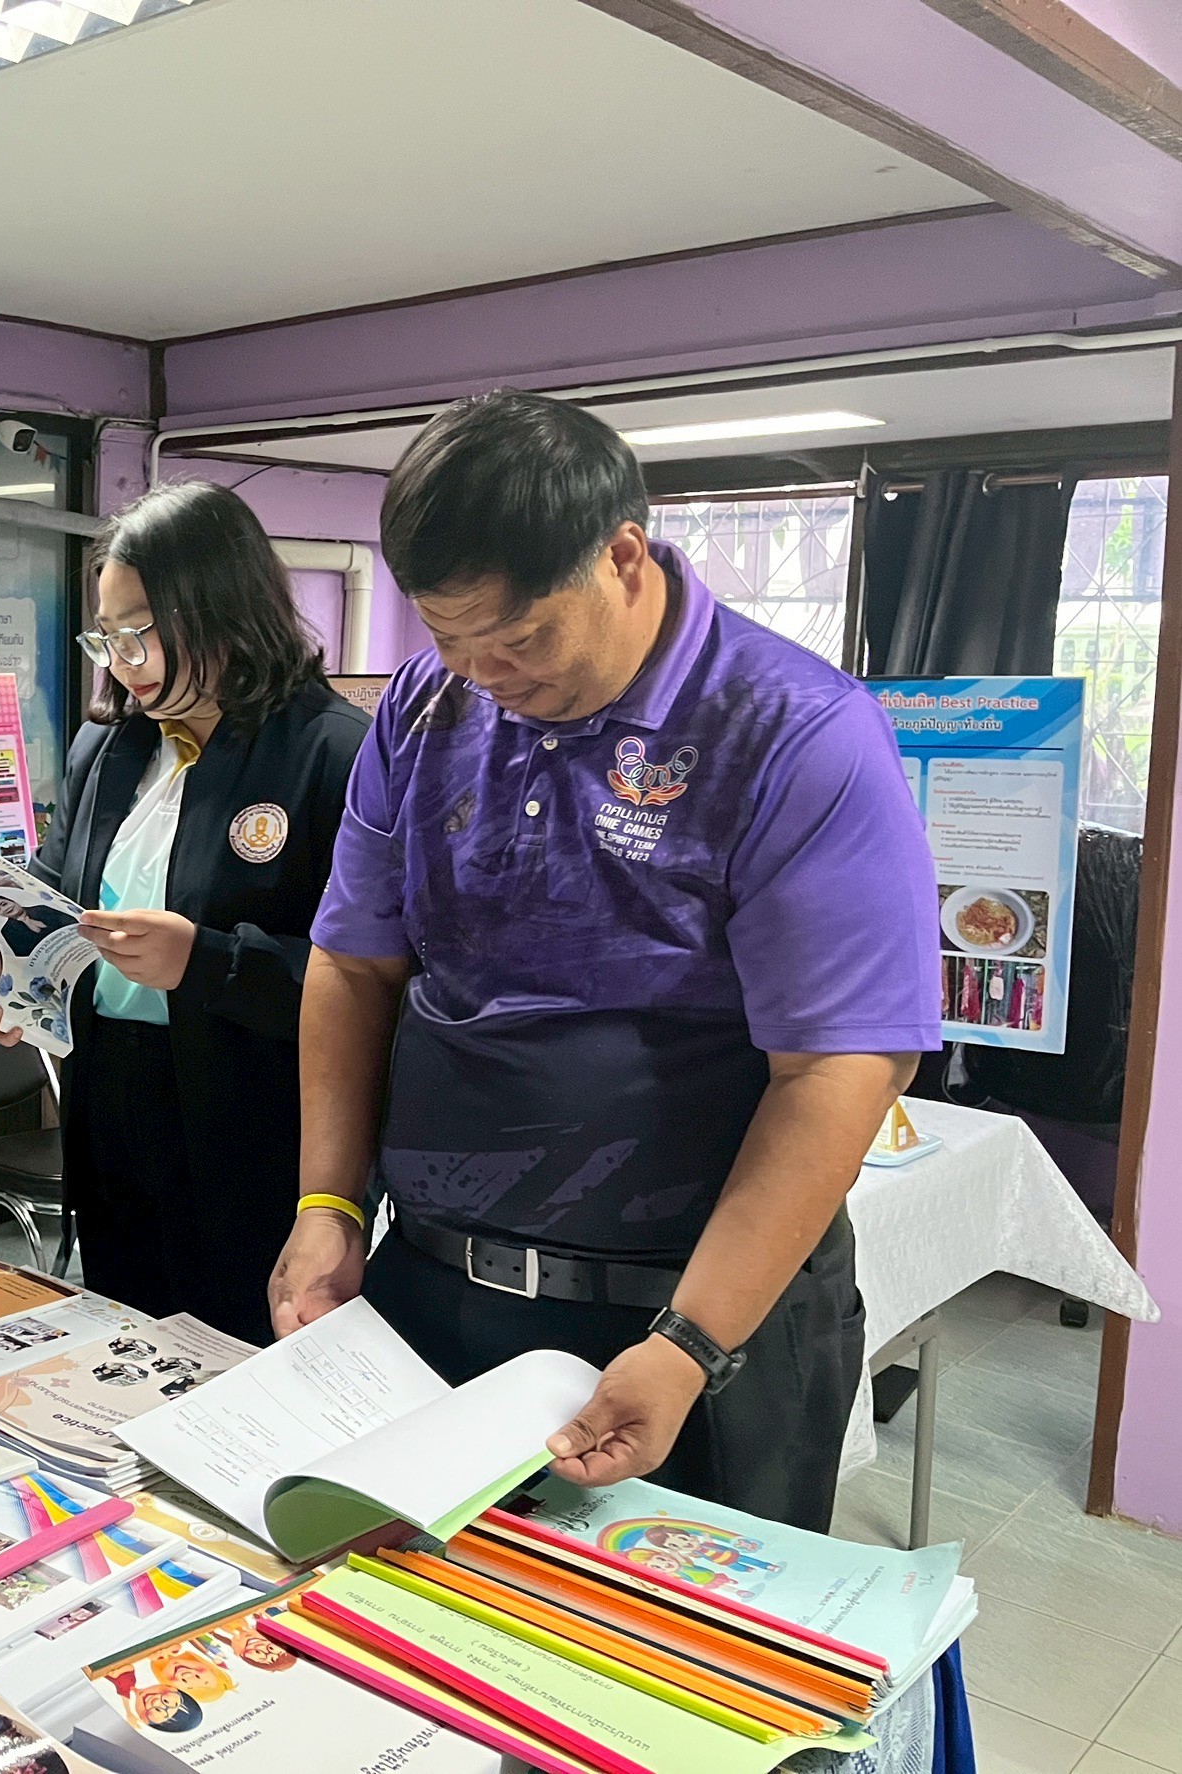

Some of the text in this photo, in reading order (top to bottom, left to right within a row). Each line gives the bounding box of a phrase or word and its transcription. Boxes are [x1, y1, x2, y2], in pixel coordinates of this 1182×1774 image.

[941, 697, 971, 708] Best
[978, 697, 1038, 709] Practice
[599, 803, 671, 826] กศน.เกมส์
[623, 822, 663, 840] GAMES
[633, 839, 657, 851] TEAM
[625, 850, 650, 862] 2023
[49, 1413, 109, 1436] Practice
[504, 1671, 652, 1754] แบบประเมินการพัฒนาทักษะ
